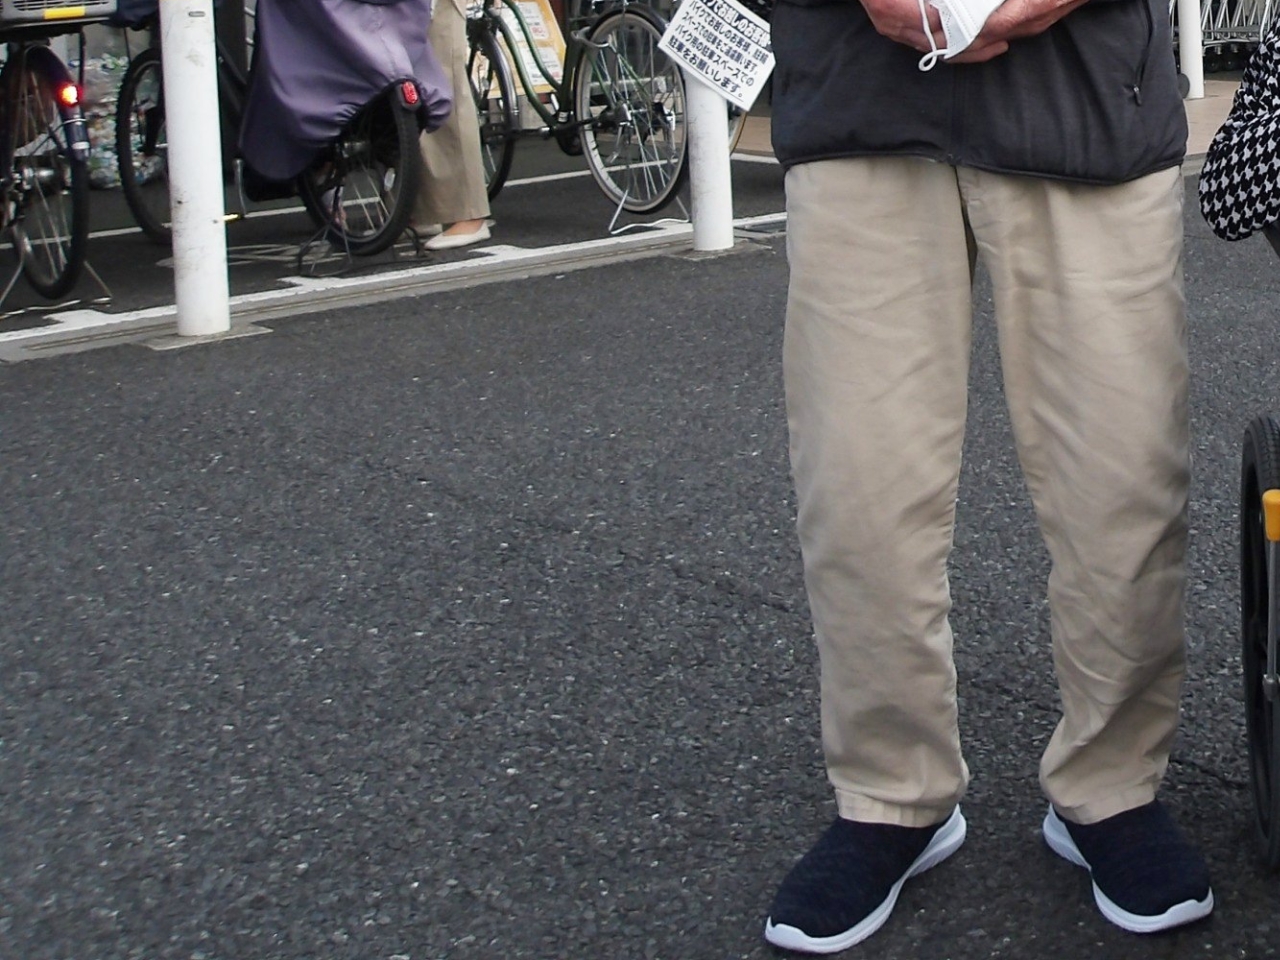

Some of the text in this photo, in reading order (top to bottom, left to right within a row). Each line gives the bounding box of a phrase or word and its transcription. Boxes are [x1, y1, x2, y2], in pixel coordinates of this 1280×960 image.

[668, 35, 743, 97] 駐車をお願いします。
[675, 24, 755, 87] バイク用の駐車スペースでの
